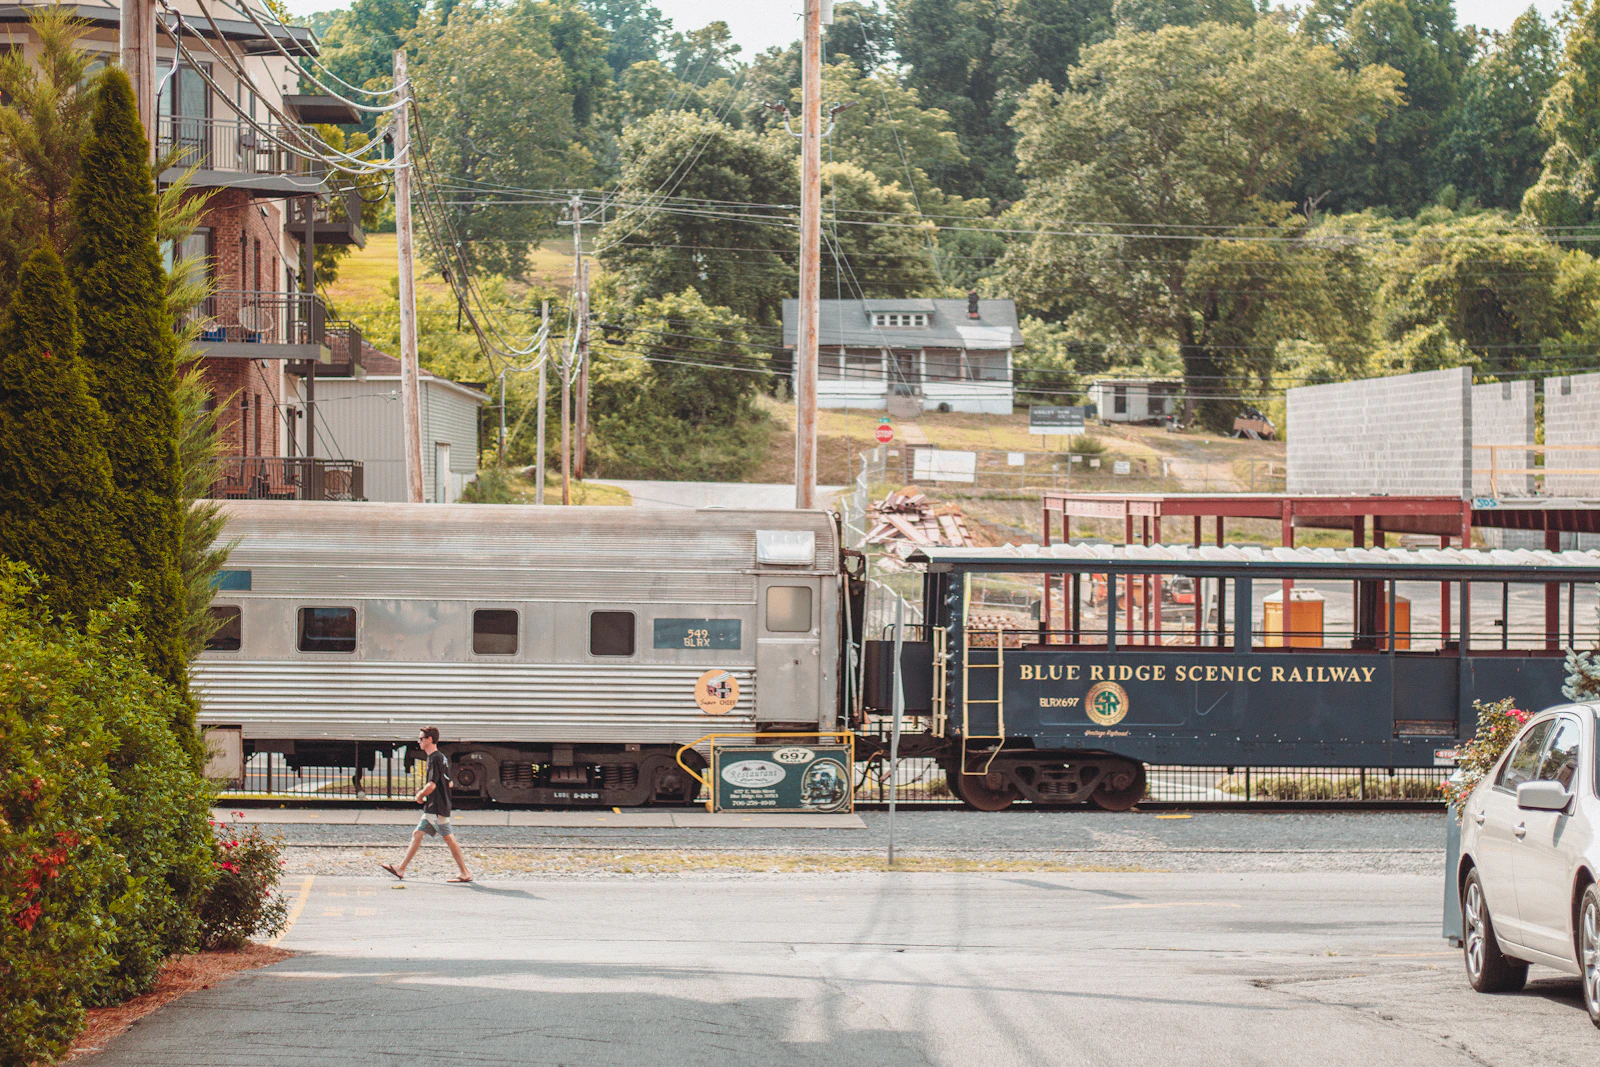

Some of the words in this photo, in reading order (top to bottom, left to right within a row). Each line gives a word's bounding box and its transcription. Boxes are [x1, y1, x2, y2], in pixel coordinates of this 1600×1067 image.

[875, 429, 894, 438] STOP
[687, 629, 709, 638] 549
[683, 637, 711, 647] BLRX
[1020, 664, 1081, 681] BLUE
[1090, 664, 1167, 681] RIDGE
[1175, 665, 1262, 682] SCENIC
[1270, 666, 1376, 683] RAILWAY
[1039, 697, 1080, 707] BLRX697
[780, 752, 809, 760] 697
[730, 770, 778, 779] Restaurant
